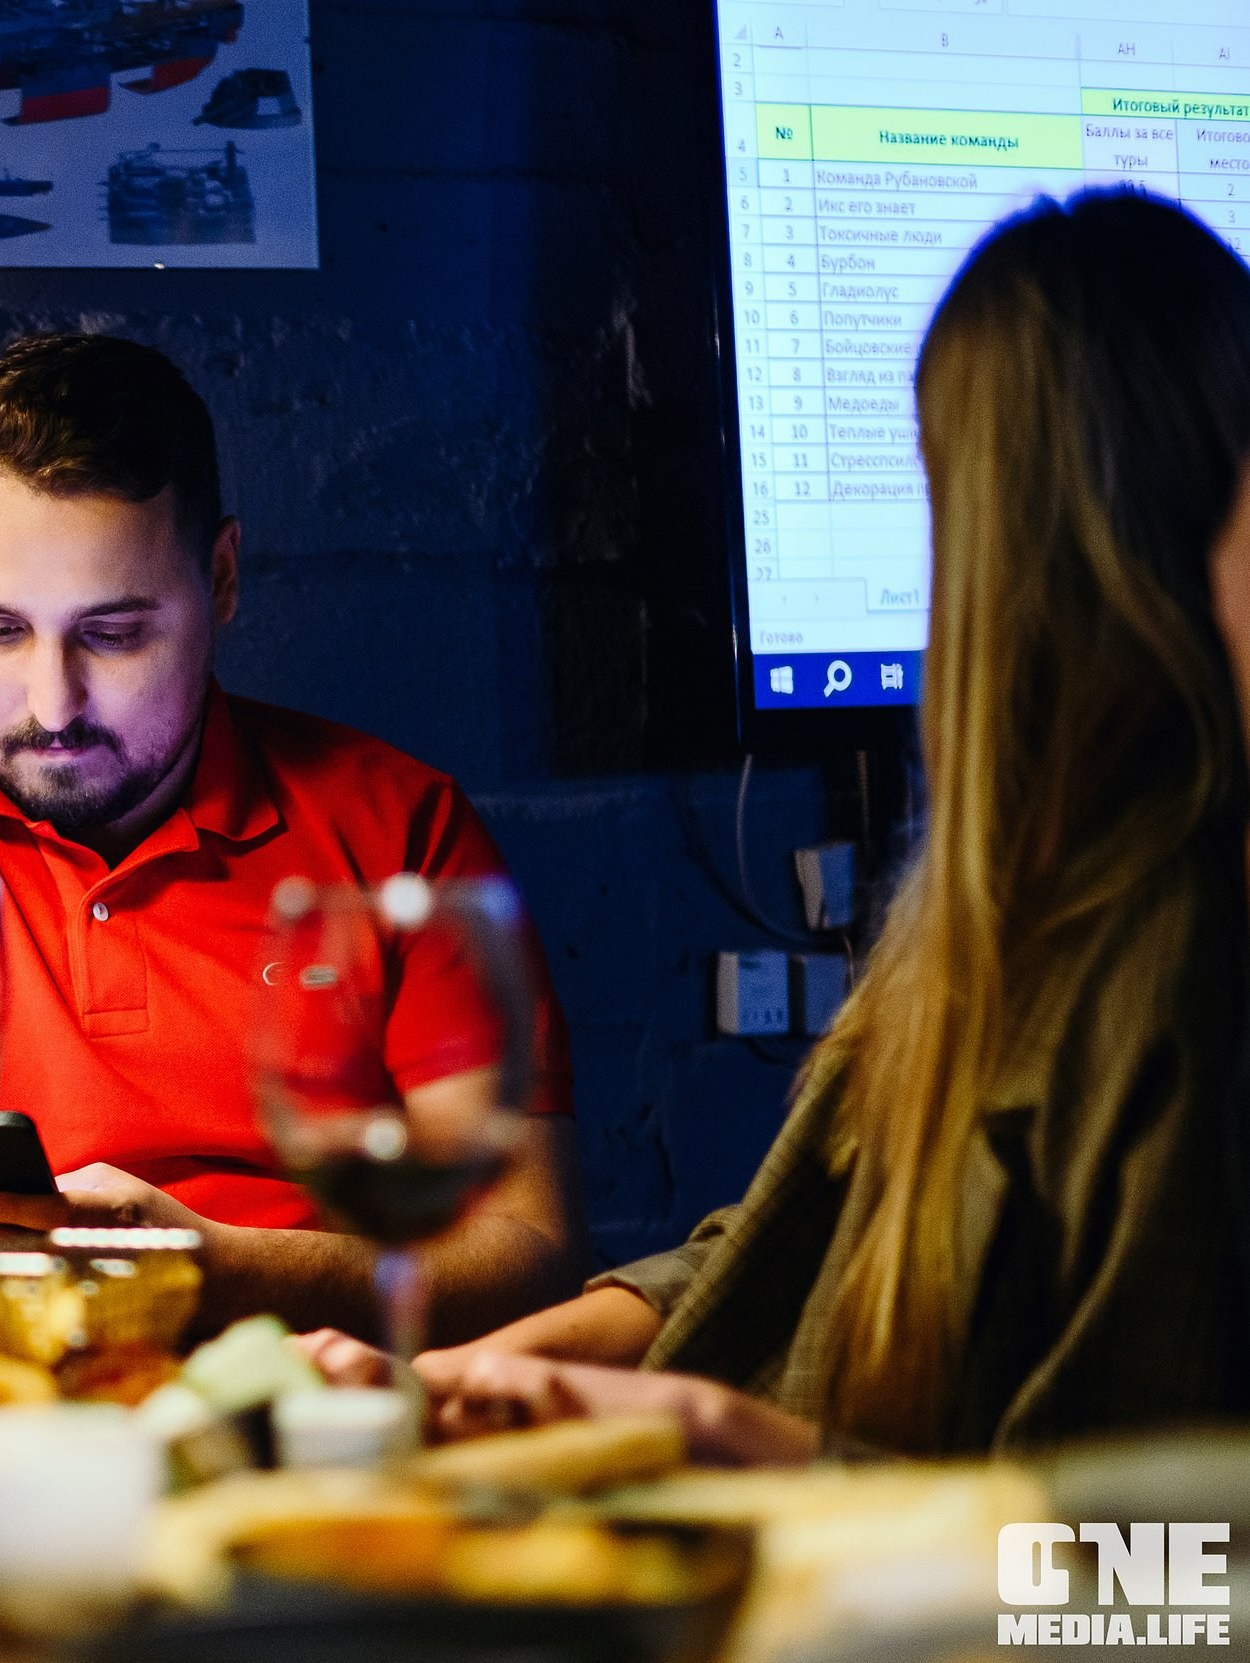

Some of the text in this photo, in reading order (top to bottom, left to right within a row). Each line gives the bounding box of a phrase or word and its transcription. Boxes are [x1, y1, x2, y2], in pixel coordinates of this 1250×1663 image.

[774, 26, 784, 39] A
[732, 53, 741, 67] 2
[734, 81, 743, 96] 3
[1112, 97, 1180, 114] Итоговый
[775, 126, 793, 140] №
[1086, 124, 1174, 140] Баллы за все
[737, 138, 746, 152] 4
[879, 130, 1019, 151] Название команды
[1114, 153, 1148, 170] туры
[1209, 157, 1250, 170] место
[739, 168, 748, 181] 5
[783, 169, 790, 183] 1
[816, 170, 977, 192] Команда Рубановской
[1228, 183, 1235, 196] 2
[741, 196, 749, 209] 6
[784, 197, 792, 211] 2
[818, 199, 915, 216] Икс его знает
[742, 224, 750, 237] 7
[786, 225, 794, 240] 3
[819, 226, 942, 245] Токсичные люди
[787, 254, 795, 267] 4
[821, 254, 876, 273] Бурбон
[789, 282, 797, 295] 5
[822, 282, 899, 302] Гладиолус
[744, 310, 760, 324] 10
[790, 311, 798, 325] 6
[824, 311, 902, 330] Попутчики
[746, 339, 761, 353] 11
[792, 339, 800, 353] 7
[826, 338, 911, 356] Бойцовские
[748, 367, 762, 381] 12
[827, 367, 876, 384] Взгляд
[879, 371, 895, 383] из
[829, 396, 899, 415] Медоеды
[750, 425, 765, 438] 14
[792, 425, 807, 439] 10
[830, 424, 886, 440] Теплые
[794, 453, 807, 467] 11
[795, 481, 810, 495] 12
[833, 481, 914, 499] Декорация
